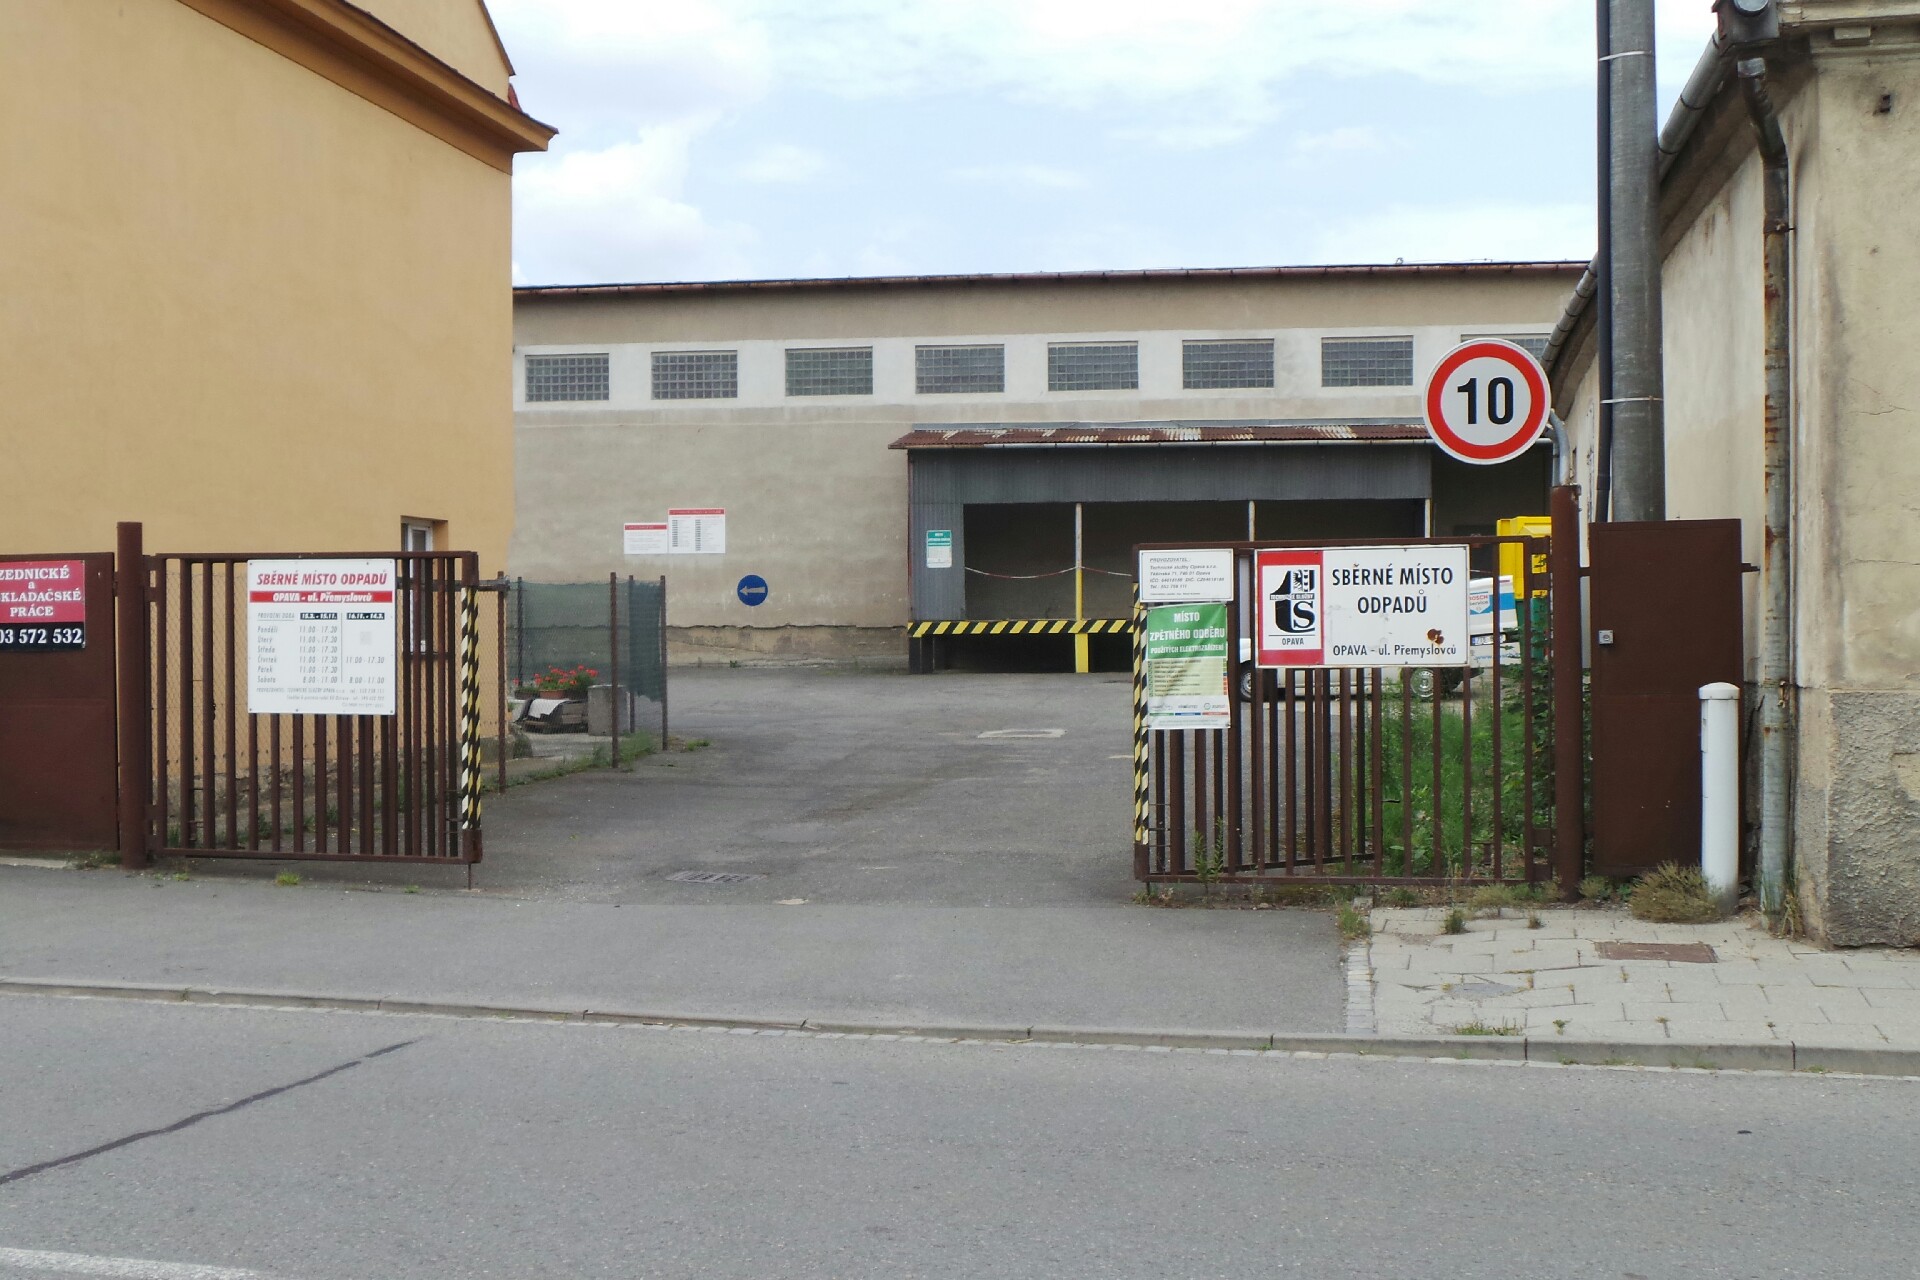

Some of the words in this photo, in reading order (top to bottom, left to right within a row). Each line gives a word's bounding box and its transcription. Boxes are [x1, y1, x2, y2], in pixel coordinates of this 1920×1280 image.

[1457, 376, 1514, 425] 10
[257, 570, 299, 585] SBĚRNÉ
[301, 569, 337, 585] MÍSTO
[341, 568, 387, 585] ODPADŮ
[1332, 563, 1394, 586] SBĚRNÉ
[1400, 562, 1454, 585] MÍSTO
[28, 581, 36, 589] a
[0, 587, 82, 602] KLADAČSKÉ
[273, 592, 300, 602] OPAVA
[308, 592, 319, 602] ul.
[320, 591, 373, 604] Přemyslovců
[1357, 589, 1427, 614] ODPADŮ
[9, 603, 54, 617] PRÁCE
[1173, 611, 1200, 623] MÍSTO
[19, 628, 47, 643] 572
[52, 628, 82, 643] 532
[1150, 628, 1191, 641] ZPĚTNÉHO
[1193, 626, 1226, 639] ODBĚRU
[1333, 645, 1368, 656] OPAVA
[1378, 644, 1391, 656] ul.
[1394, 644, 1457, 658] Přemyslovců
